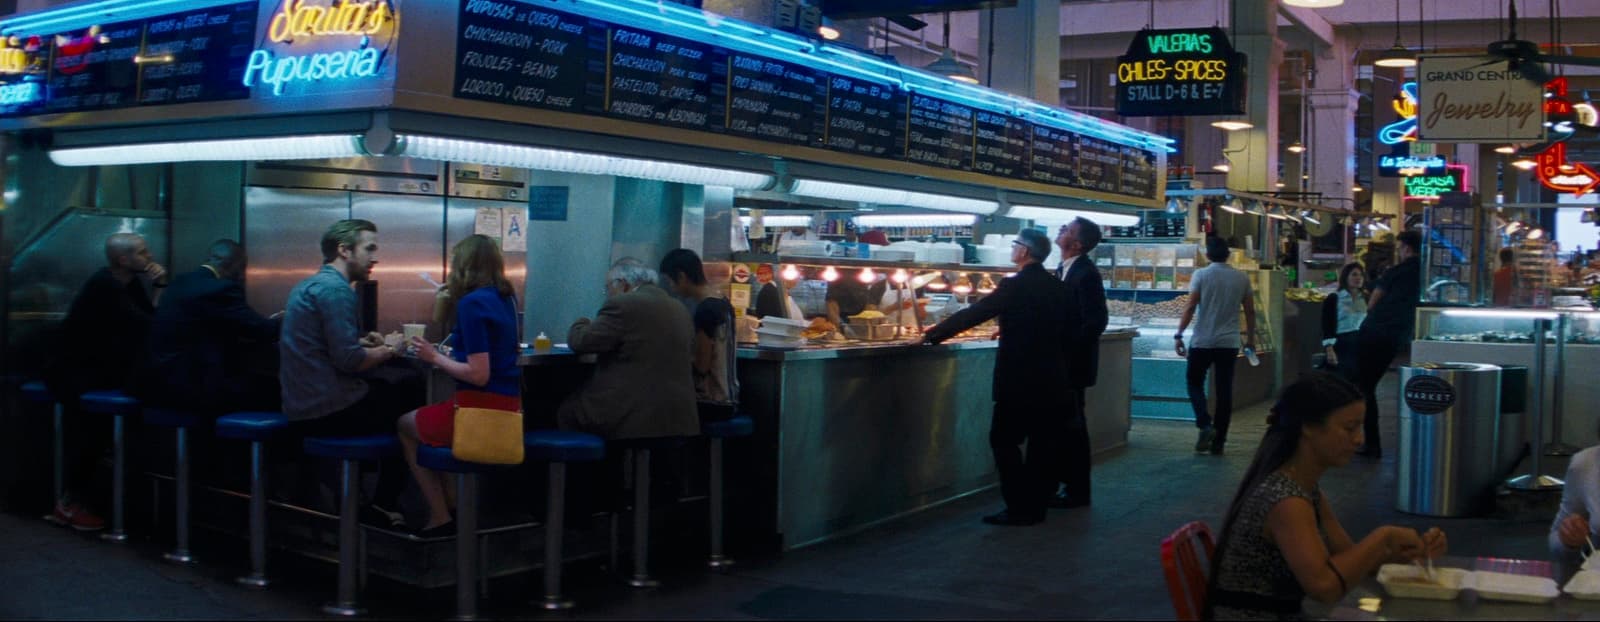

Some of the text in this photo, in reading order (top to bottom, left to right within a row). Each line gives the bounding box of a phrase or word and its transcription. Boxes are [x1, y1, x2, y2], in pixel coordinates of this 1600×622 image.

[465, 0, 517, 20] PUPUSAS
[528, 10, 560, 29] QUESO
[464, 24, 533, 49] CHICHARRON
[540, 38, 568, 56] PORK
[1146, 33, 1213, 54] VALERIA'S
[521, 60, 560, 79] BEANS
[1427, 70, 1522, 81] GRAND CENTR
[460, 78, 504, 97] LOROCO
[512, 85, 545, 103] QUESO
[1127, 83, 1224, 102] STALL D-6 & E-7
[1425, 92, 1535, 129] Jewelry
[508, 215, 521, 236] A
[1407, 391, 1451, 401] MARKET
